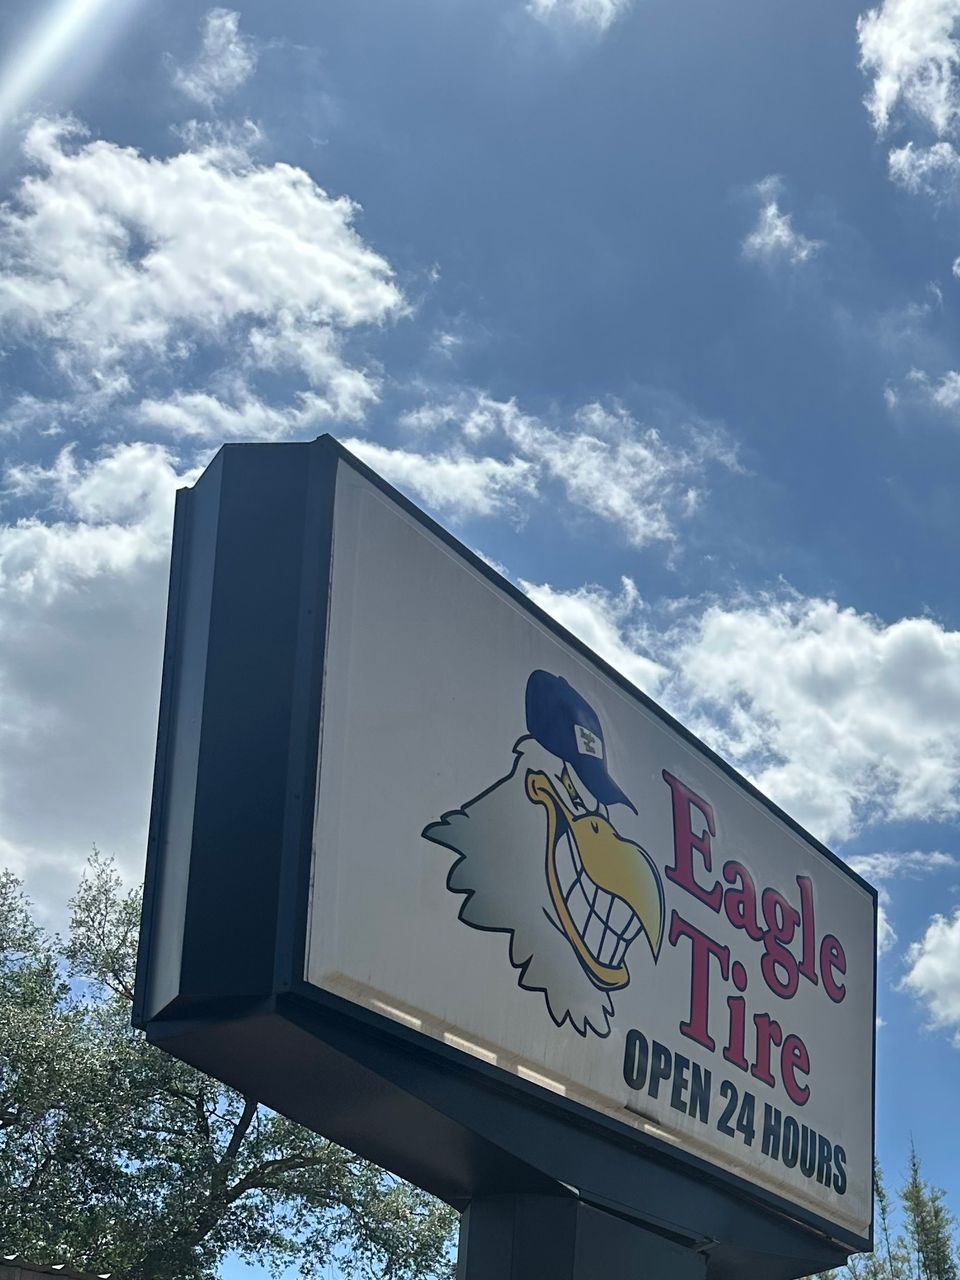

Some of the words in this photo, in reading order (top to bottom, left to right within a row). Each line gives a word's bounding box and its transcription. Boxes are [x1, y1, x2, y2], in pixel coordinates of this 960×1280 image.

[661, 768, 847, 1004] Eagle
[668, 909, 811, 1107] Tire
[623, 1029, 712, 1125] OPEN
[717, 1079, 756, 1147] 24
[761, 1102, 848, 1195] HOURS
